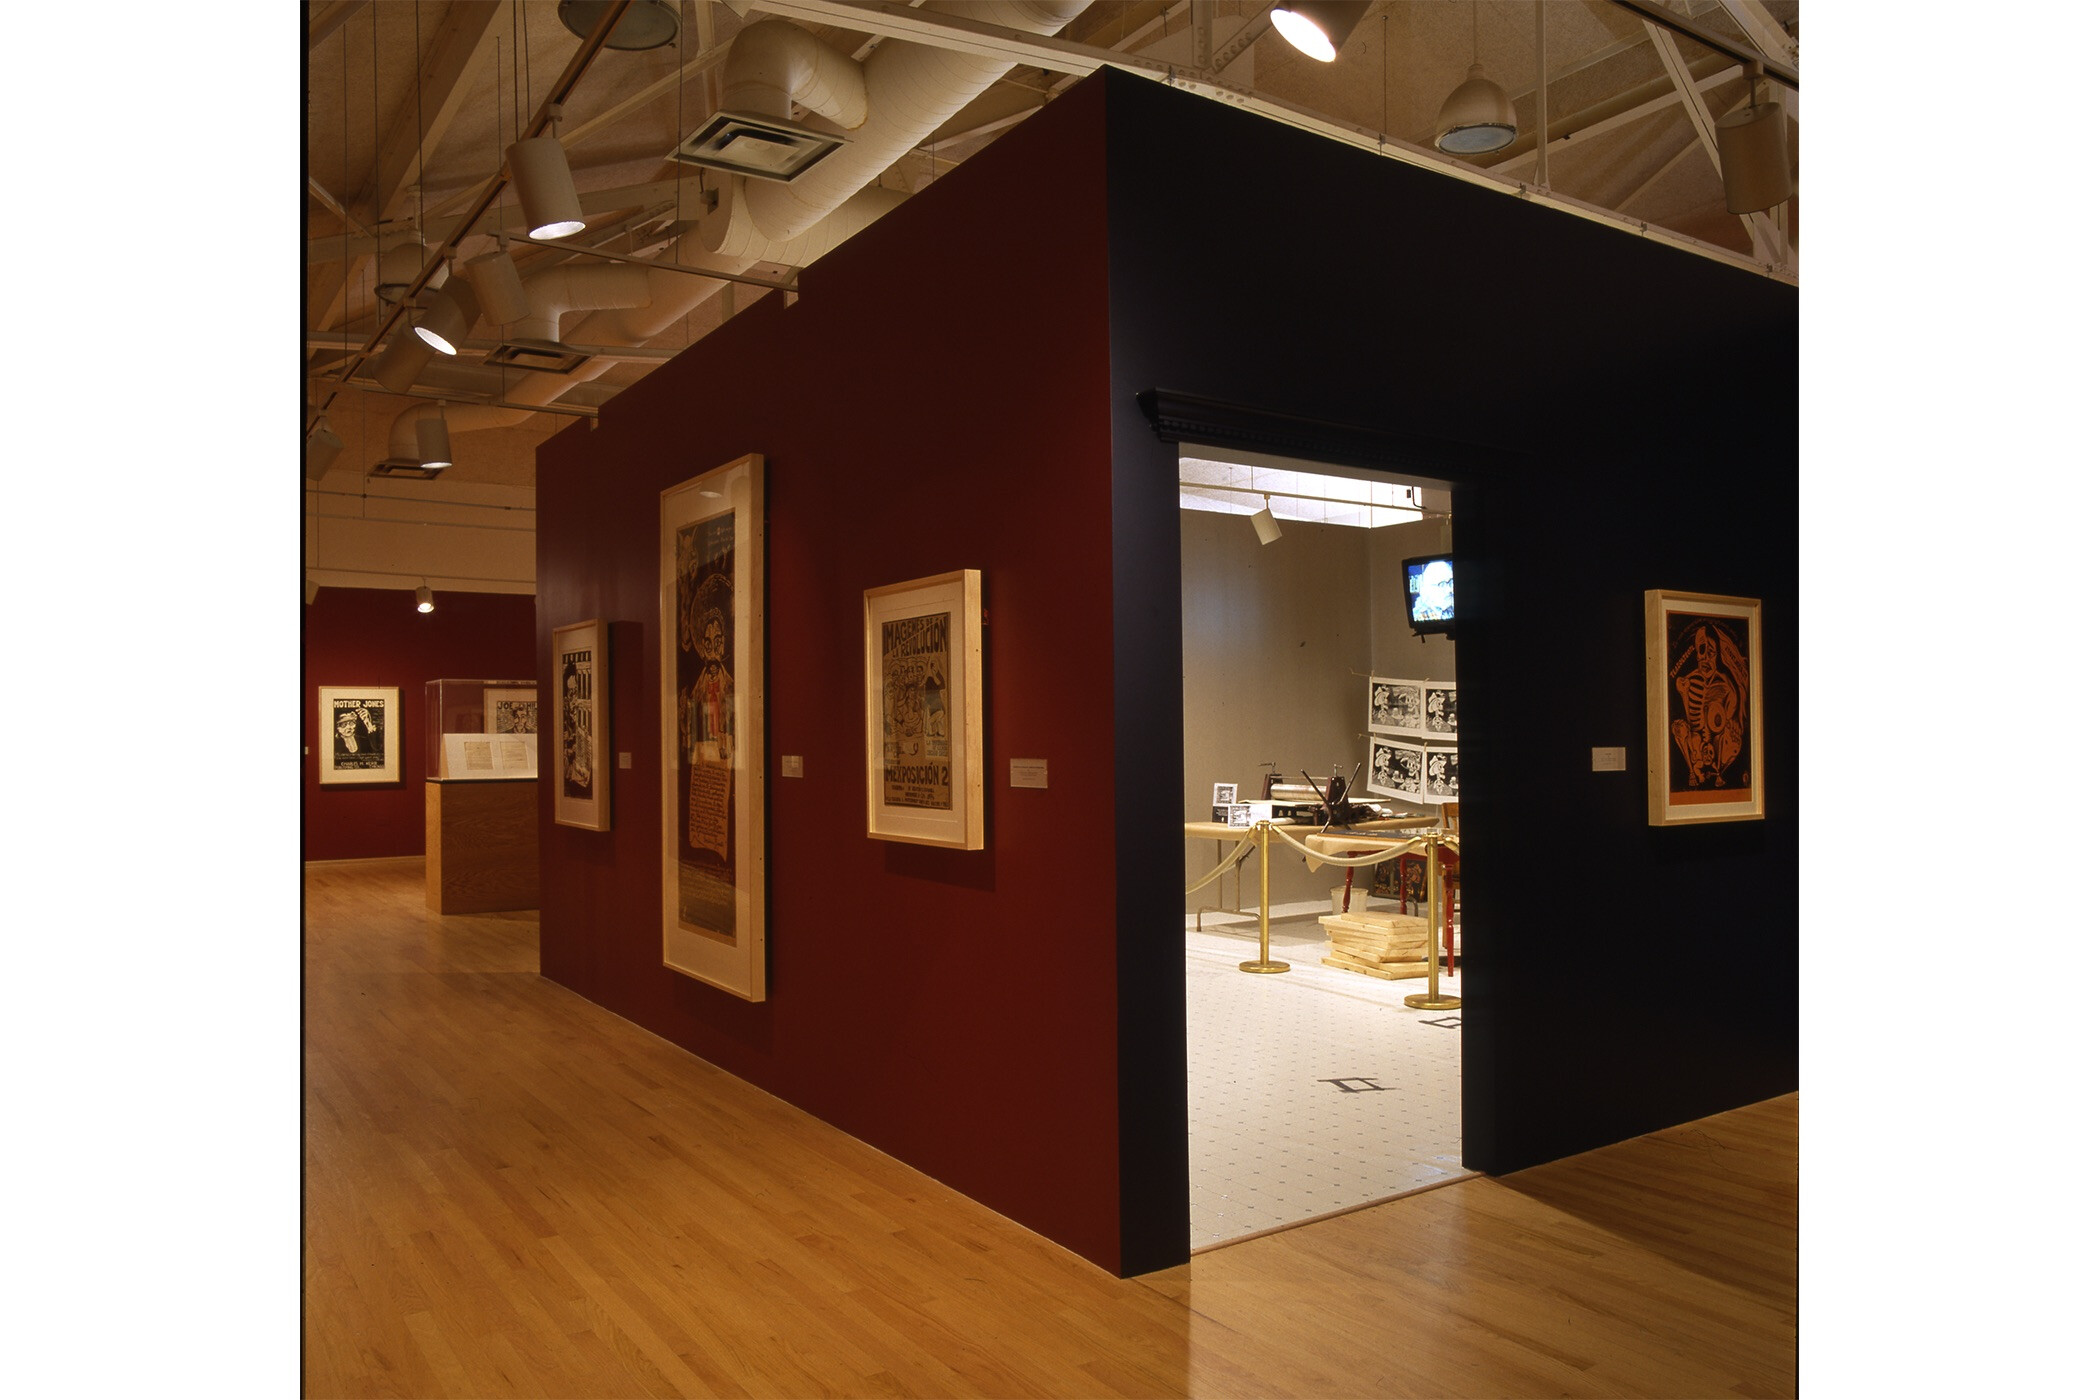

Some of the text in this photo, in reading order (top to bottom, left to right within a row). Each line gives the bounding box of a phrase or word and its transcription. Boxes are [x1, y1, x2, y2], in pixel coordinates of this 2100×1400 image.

[334, 700, 384, 708] MOTHER JONES
[497, 701, 538, 710] JOE HIL
[886, 762, 949, 787] MEXPOSICIÓN 2
